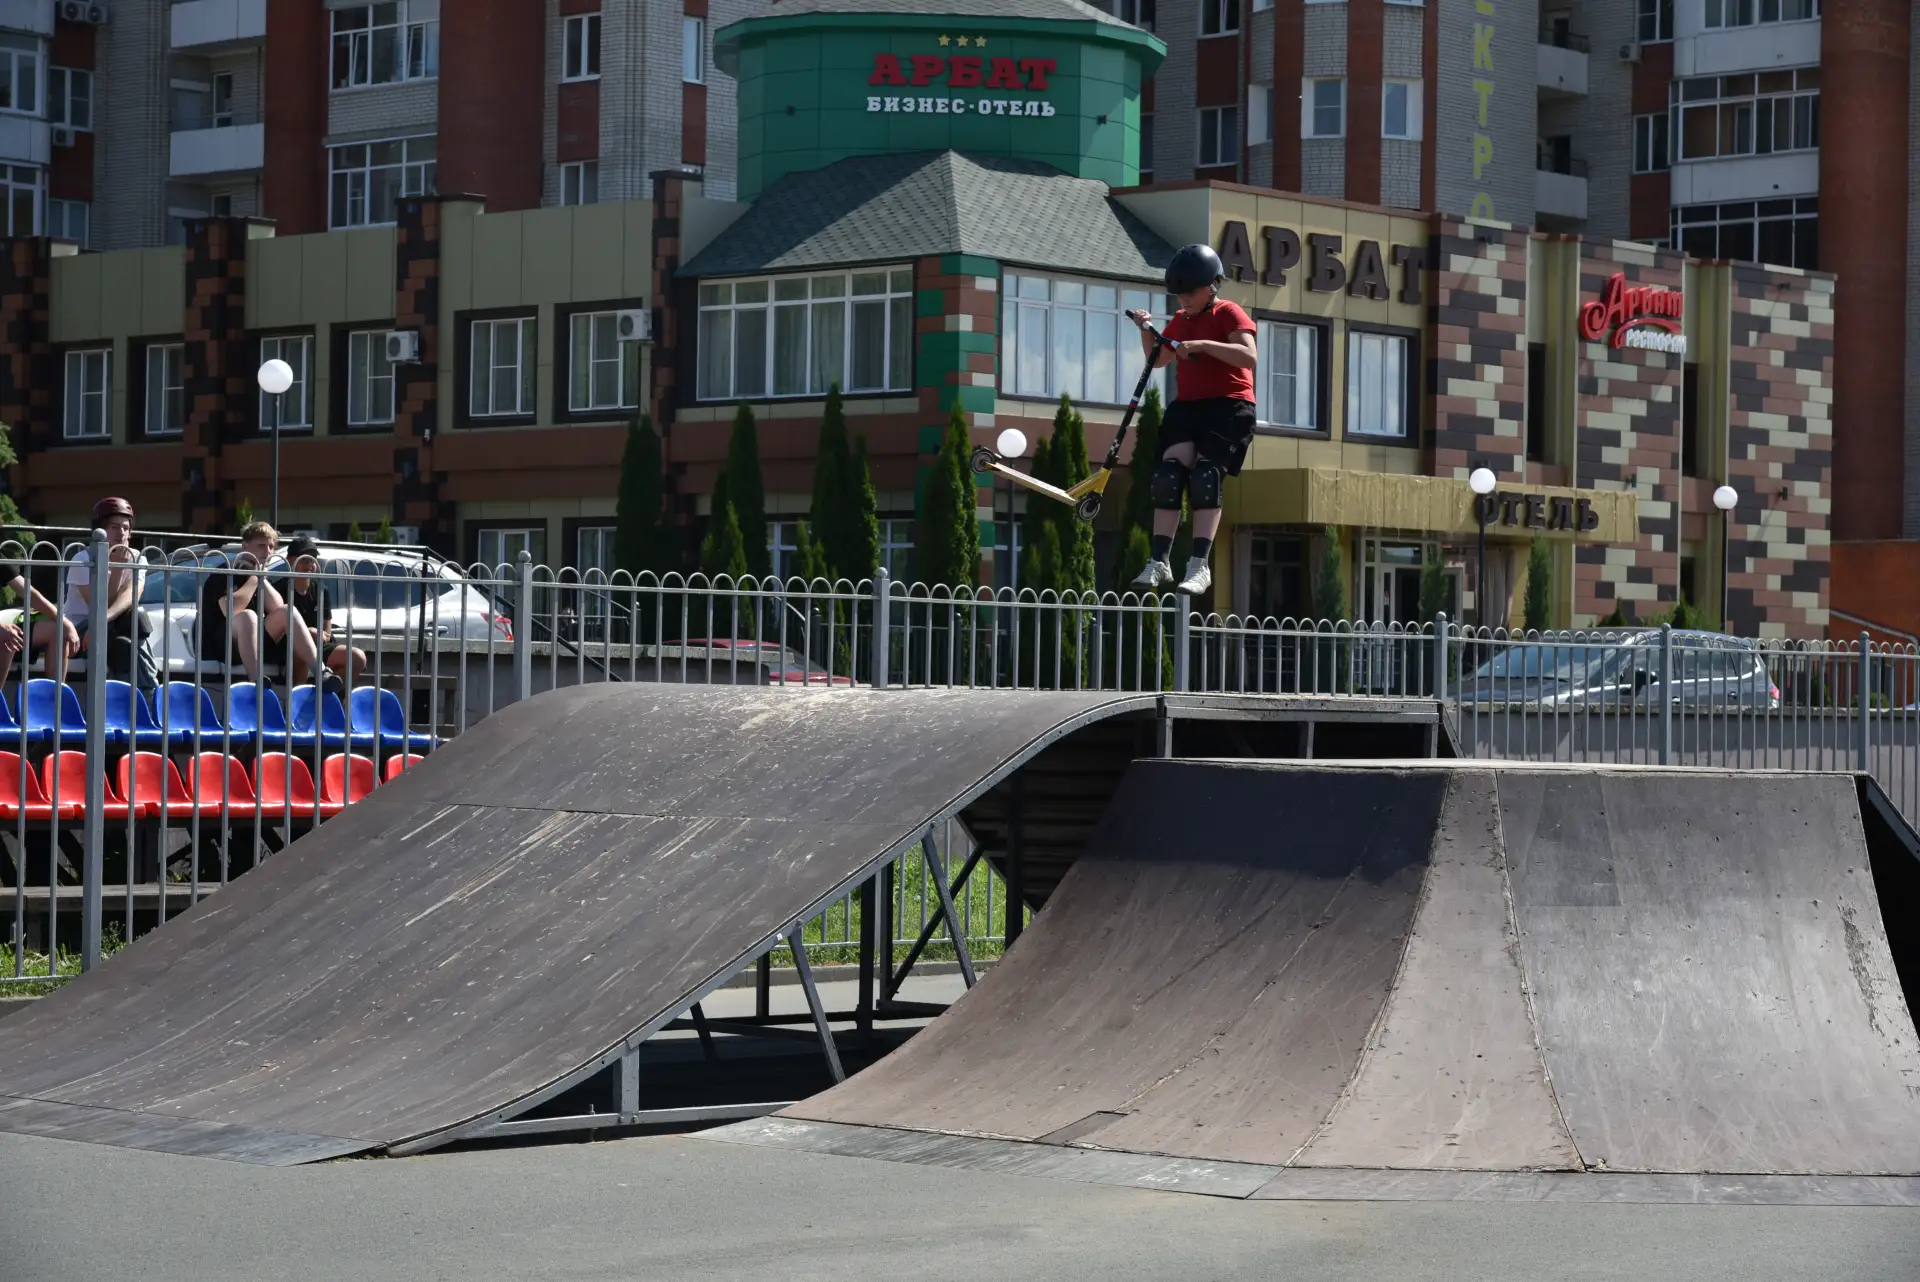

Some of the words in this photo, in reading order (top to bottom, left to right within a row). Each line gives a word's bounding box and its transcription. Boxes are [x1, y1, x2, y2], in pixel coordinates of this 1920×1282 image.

[868, 54, 1057, 90] АРБАТ
[1219, 220, 1427, 305] АРБАТ
[1475, 490, 1599, 532] ОТЕЛЬ
